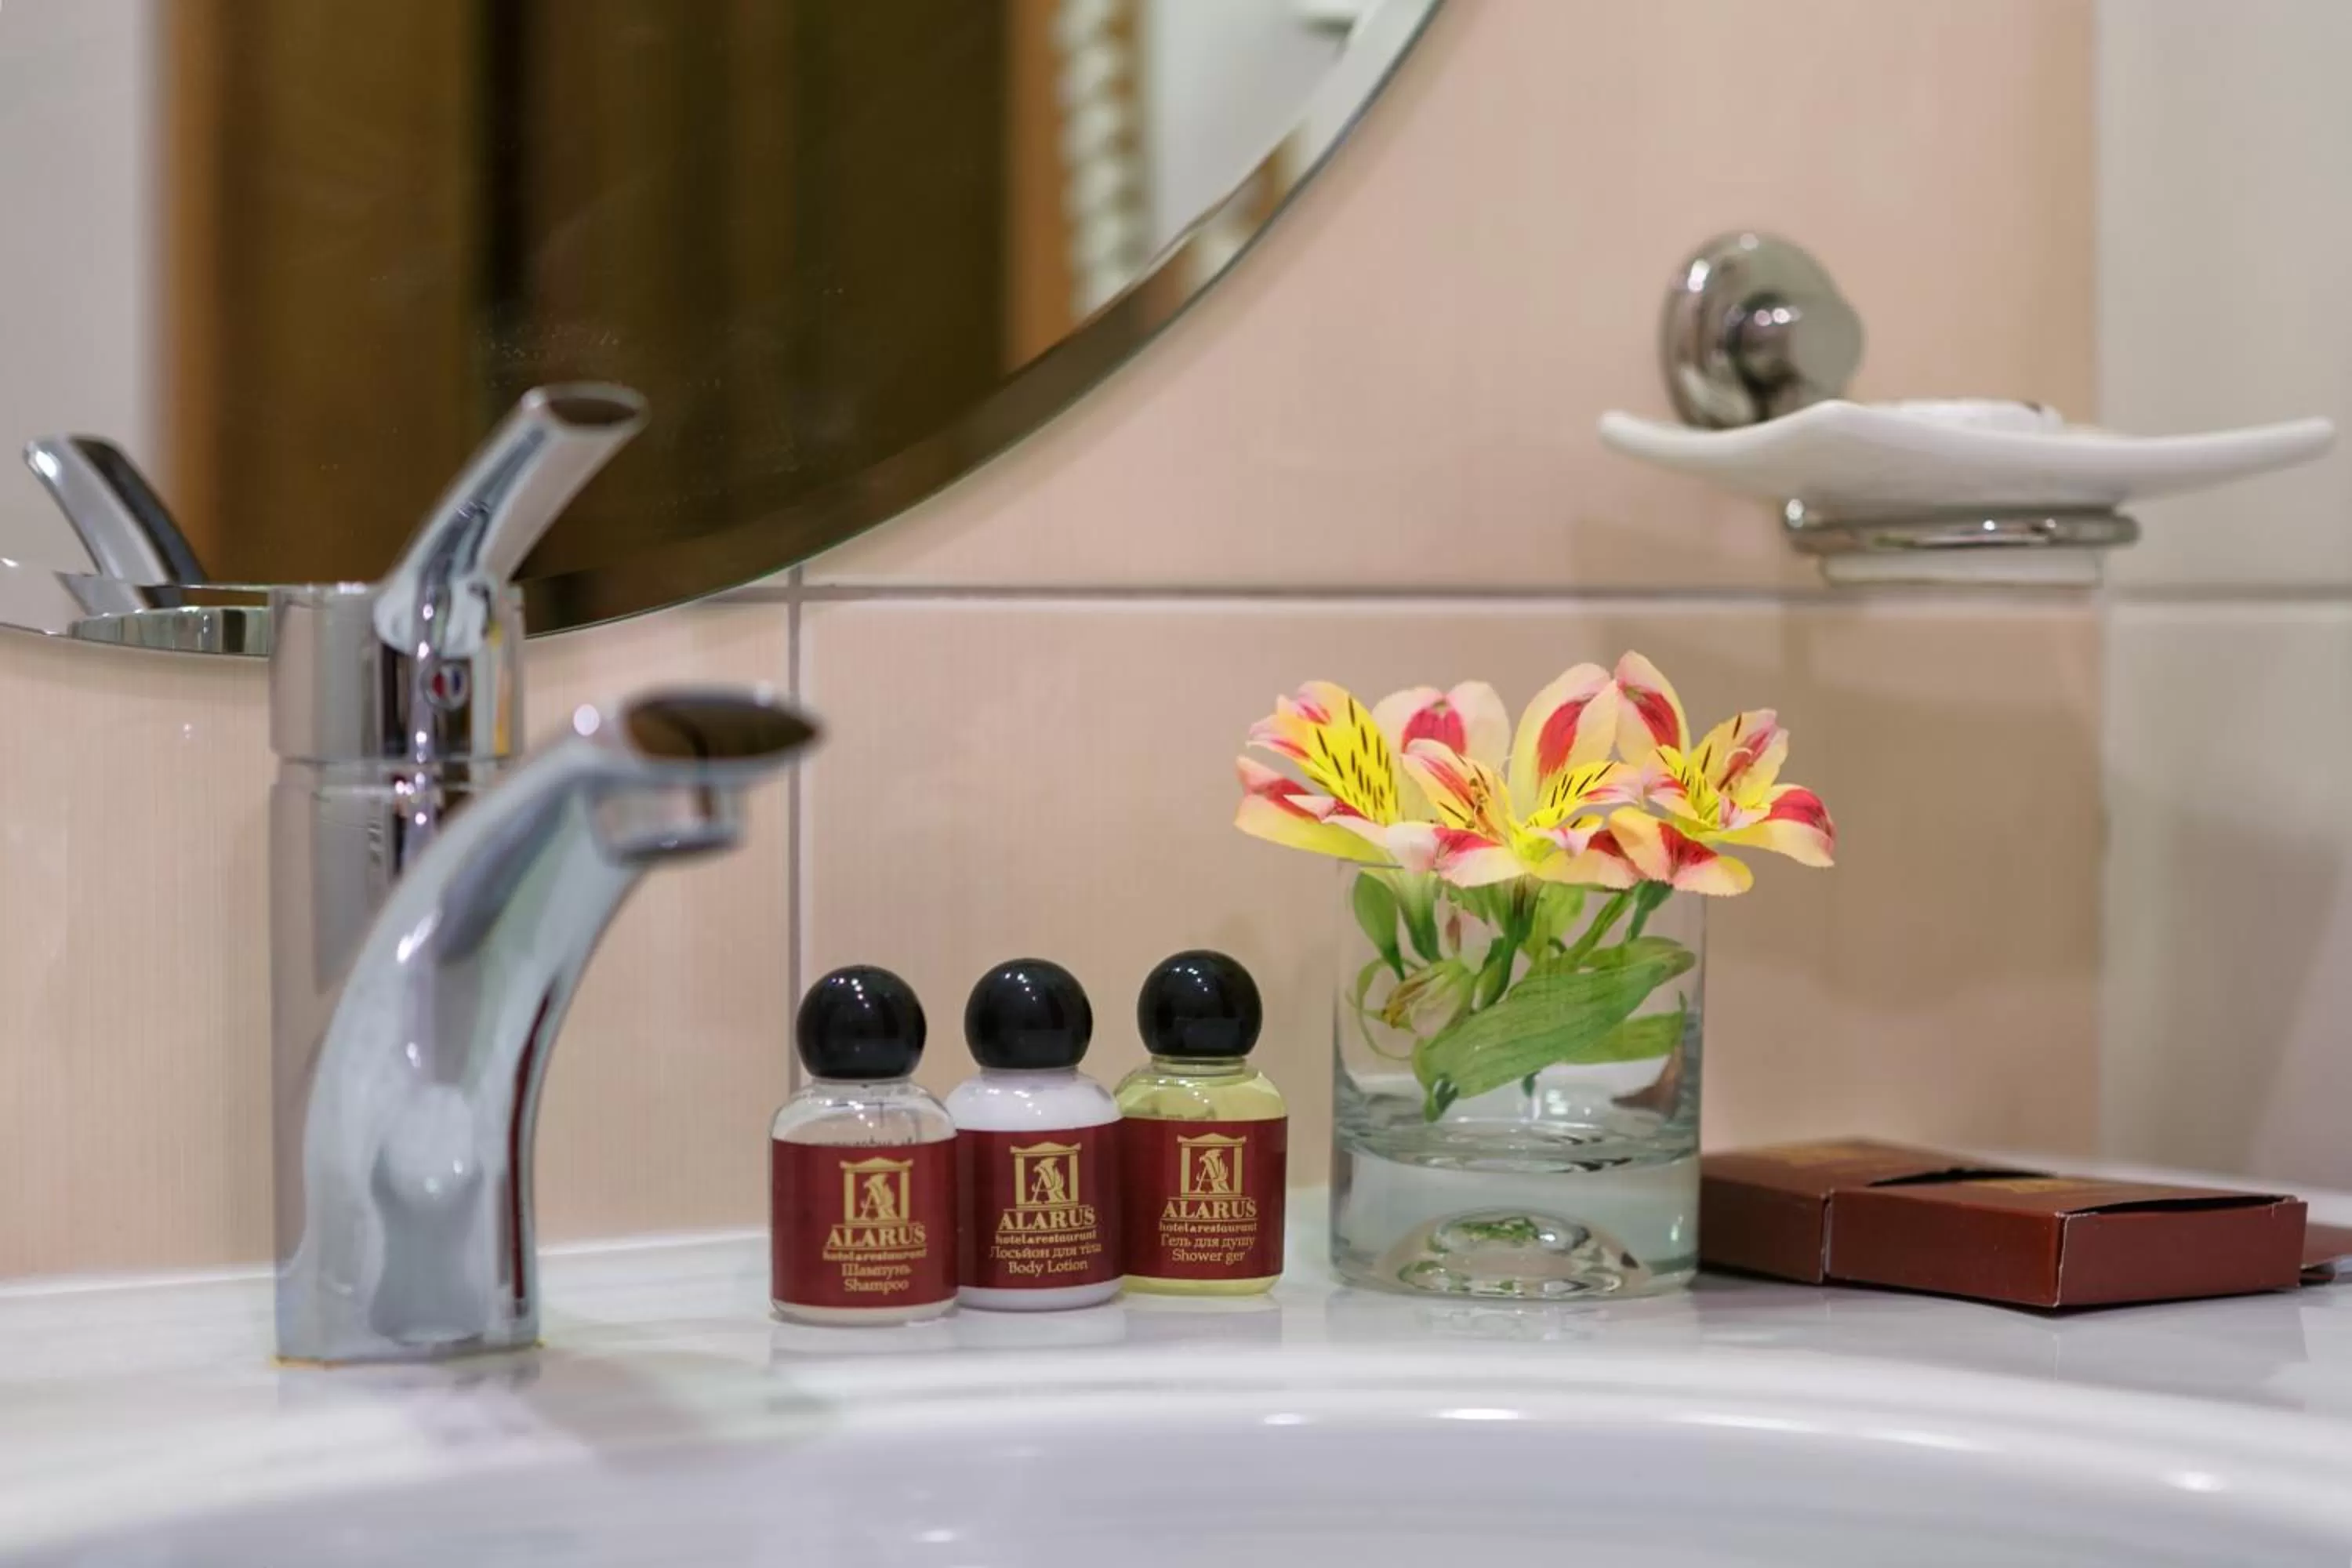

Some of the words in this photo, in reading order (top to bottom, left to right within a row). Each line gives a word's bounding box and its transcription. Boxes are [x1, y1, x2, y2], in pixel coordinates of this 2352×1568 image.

[1163, 1200, 1258, 1218] ALARUS
[1000, 1207, 1095, 1230] ALARUS
[826, 1224, 926, 1247] ALARUS
[1172, 1248, 1223, 1261] Shower
[1008, 1261, 1044, 1277] Body
[1047, 1259, 1089, 1273] Lotion
[844, 1279, 909, 1295] Shampoo
